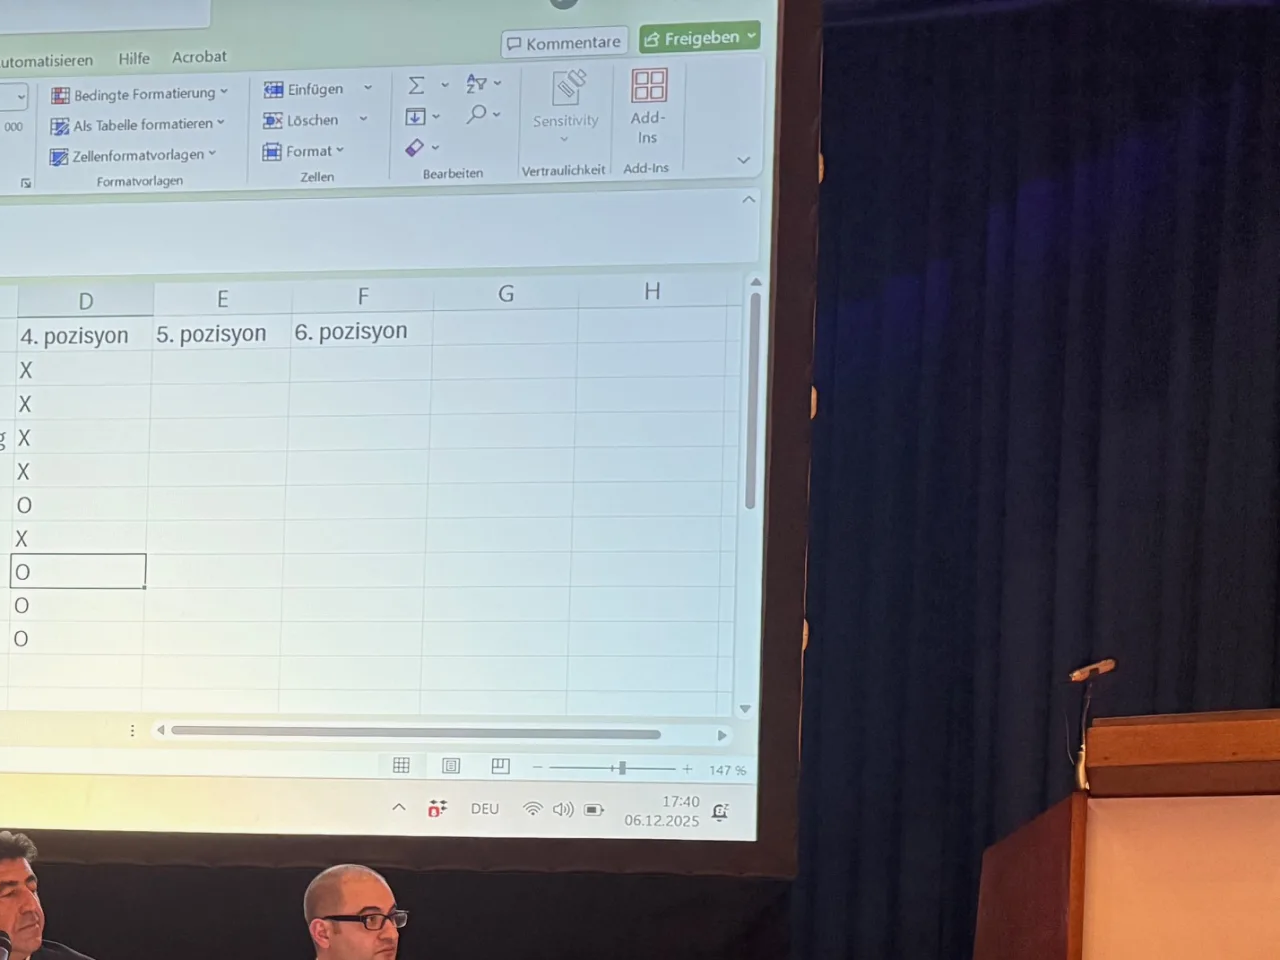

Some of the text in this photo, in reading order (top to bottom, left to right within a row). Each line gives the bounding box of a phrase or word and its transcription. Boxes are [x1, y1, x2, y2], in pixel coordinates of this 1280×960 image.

[526, 37, 621, 50] Kommentare
[665, 30, 739, 48] Freigeben
[119, 52, 150, 65] Hilfe
[172, 50, 226, 63] Acrobat
[74, 88, 215, 103] Bedingte Formatierung
[288, 83, 343, 98] Einfügen
[73, 118, 213, 131] Als Tabelle formatieren
[287, 114, 338, 126] Löschen
[533, 115, 598, 128] Sensitivity
[630, 111, 665, 124] Add-
[638, 132, 657, 143] Ins
[72, 148, 204, 163] Zellenformatvorlagen
[286, 146, 332, 157] Format
[423, 168, 483, 179] Bearbeiten
[521, 164, 605, 176] Vertraulichkeit
[623, 163, 669, 174] Add-Ins
[96, 175, 183, 188] Formatvorlagen
[300, 172, 334, 182] Zellen
[79, 293, 93, 310] D
[218, 290, 228, 307] E
[359, 288, 368, 305] F
[498, 285, 513, 302] G
[645, 282, 660, 300] H
[20, 327, 128, 349] 4. pozisyon
[156, 325, 266, 347] 5. pozisyon
[294, 322, 407, 344] 6. pozisyon
[20, 361, 32, 378] X
[19, 396, 31, 412] X
[19, 429, 30, 446] X
[17, 463, 29, 480] X
[17, 497, 31, 513] O
[16, 530, 27, 547] X
[14, 564, 30, 580] O
[14, 597, 29, 613] O
[13, 631, 28, 647] O
[709, 765, 747, 775] 147 %
[471, 803, 499, 814] DEU
[663, 796, 700, 807] 17:40
[624, 815, 699, 827] 06.12.2025
